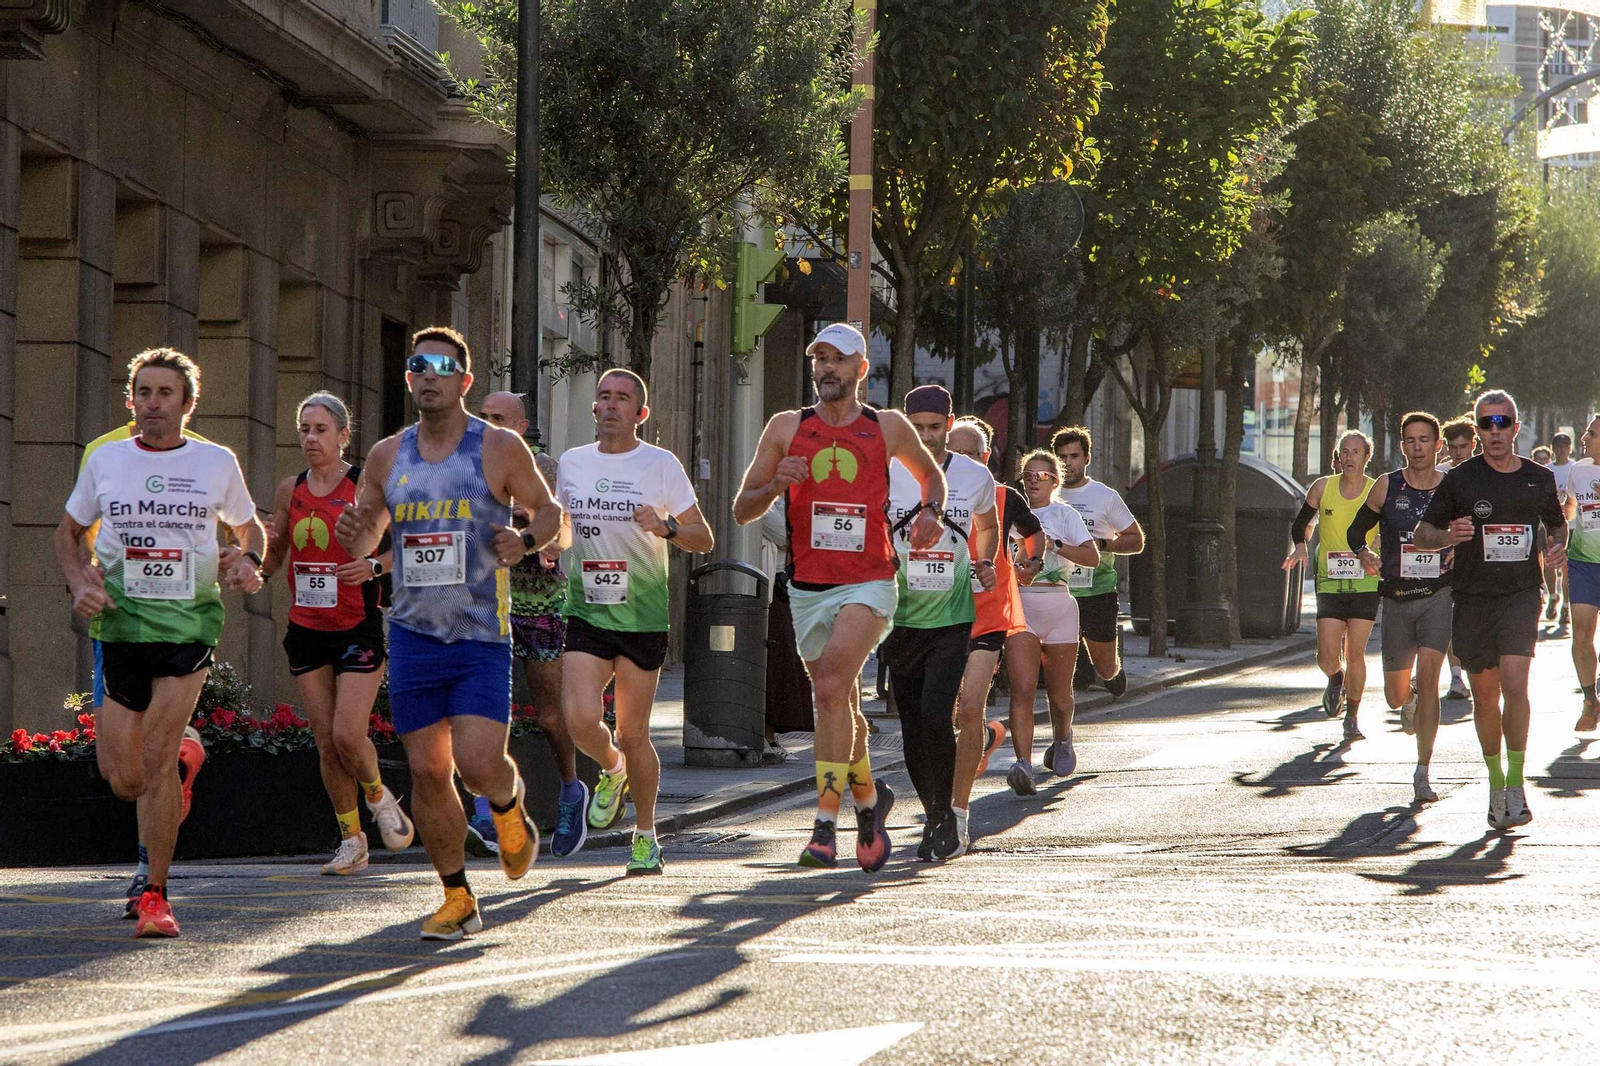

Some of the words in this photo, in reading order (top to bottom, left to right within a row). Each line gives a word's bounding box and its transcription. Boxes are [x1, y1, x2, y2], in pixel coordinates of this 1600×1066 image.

[109, 501, 132, 516] En
[138, 500, 207, 518] Marcha
[570, 498, 583, 509] En
[587, 497, 644, 512] March
[394, 499, 473, 523] BIKILA
[603, 513, 632, 522] cáncer
[113, 521, 144, 529] contra
[146, 520, 156, 528] el
[160, 520, 194, 530] cáncer
[833, 518, 853, 531] 56
[1497, 535, 1520, 546] 335
[414, 548, 445, 563] 307
[1415, 554, 1434, 564] 417
[925, 562, 945, 574] 115
[1336, 559, 1355, 567] 390
[143, 563, 174, 577] 626
[309, 577, 325, 589] 55
[594, 573, 621, 585] 642
